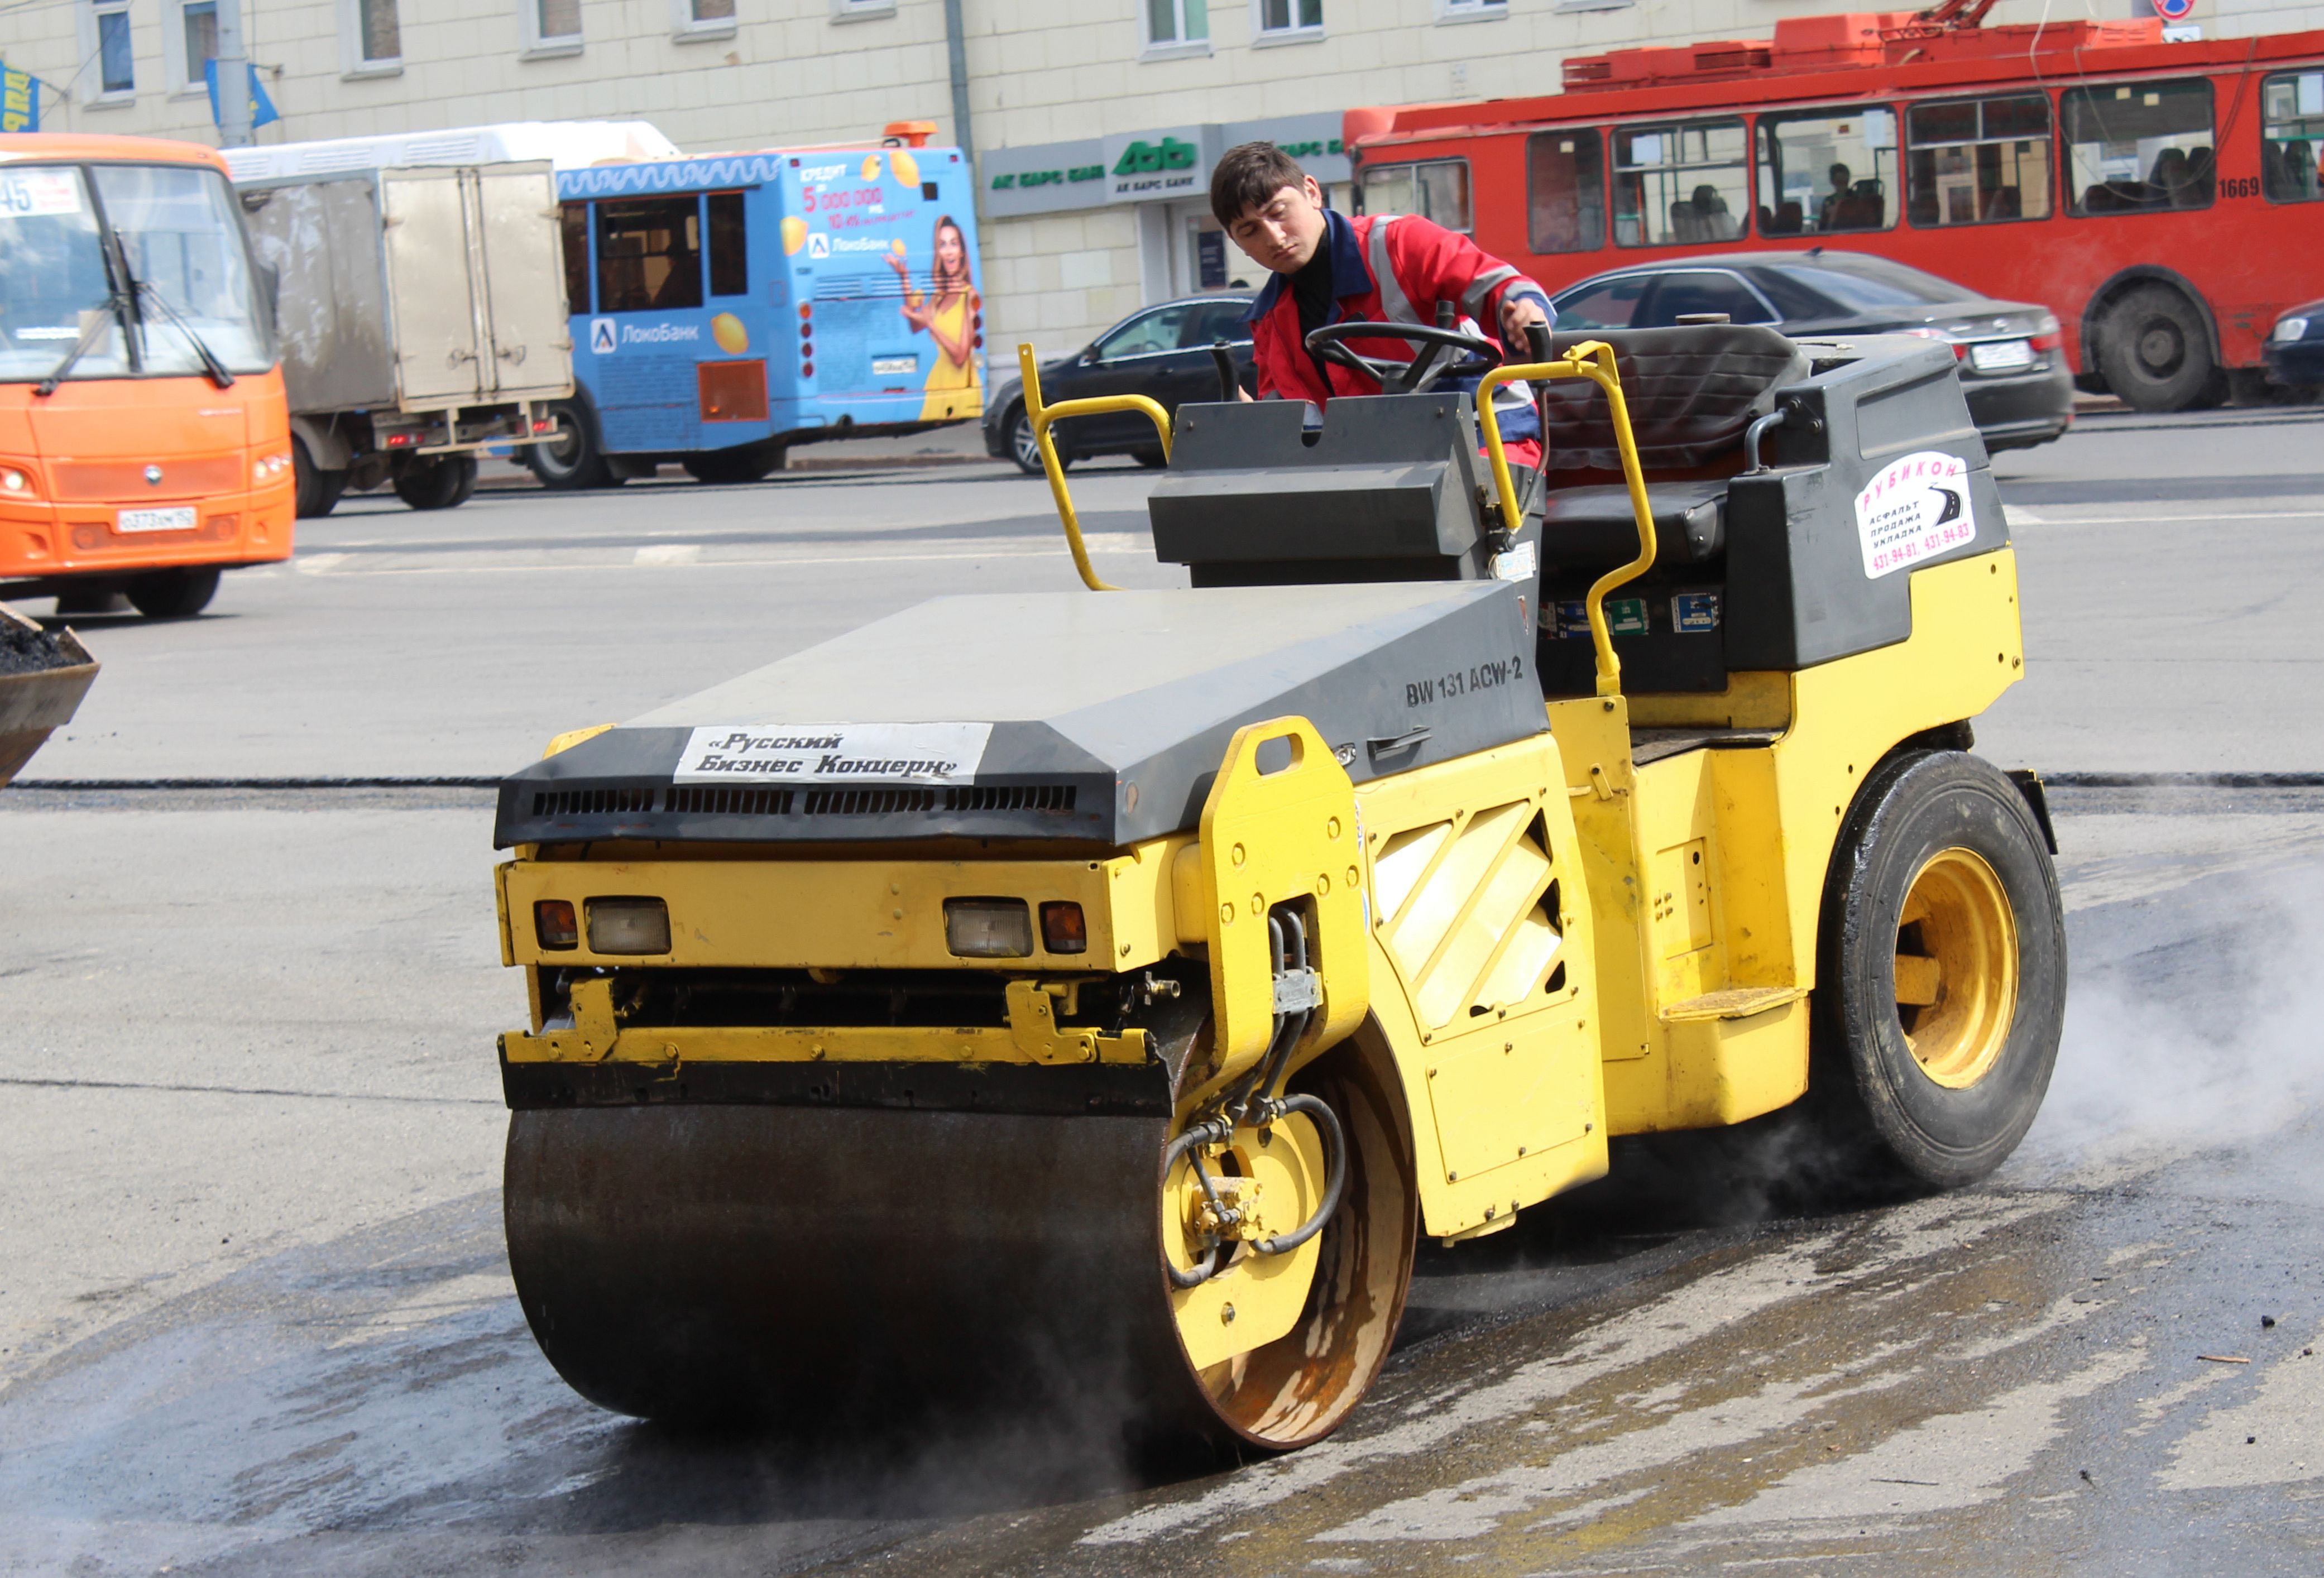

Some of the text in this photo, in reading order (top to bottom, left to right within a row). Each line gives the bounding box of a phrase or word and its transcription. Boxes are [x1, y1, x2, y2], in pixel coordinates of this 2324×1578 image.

[1019, 170, 1063, 187] БАРС
[1134, 180, 1161, 191] БАРС
[1166, 176, 1194, 188] БАНК
[2218, 177, 2260, 199] 1669
[803, 186, 816, 213] 5
[622, 323, 699, 344] ЛокоБанк
[1863, 461, 1957, 512] РУБИКОН
[1869, 501, 1919, 526] АСФАЛЬТ
[1870, 513, 1921, 538] ПРОДАЖА
[1873, 525, 1922, 549] УКЛАДКА
[1873, 522, 1970, 571] 431-94-81, 431-94-83
[1406, 655, 1523, 708] BW 131 ACW-2
[708, 732, 845, 754] «Русский
[695, 754, 957, 778] Бизнес Концерн»
